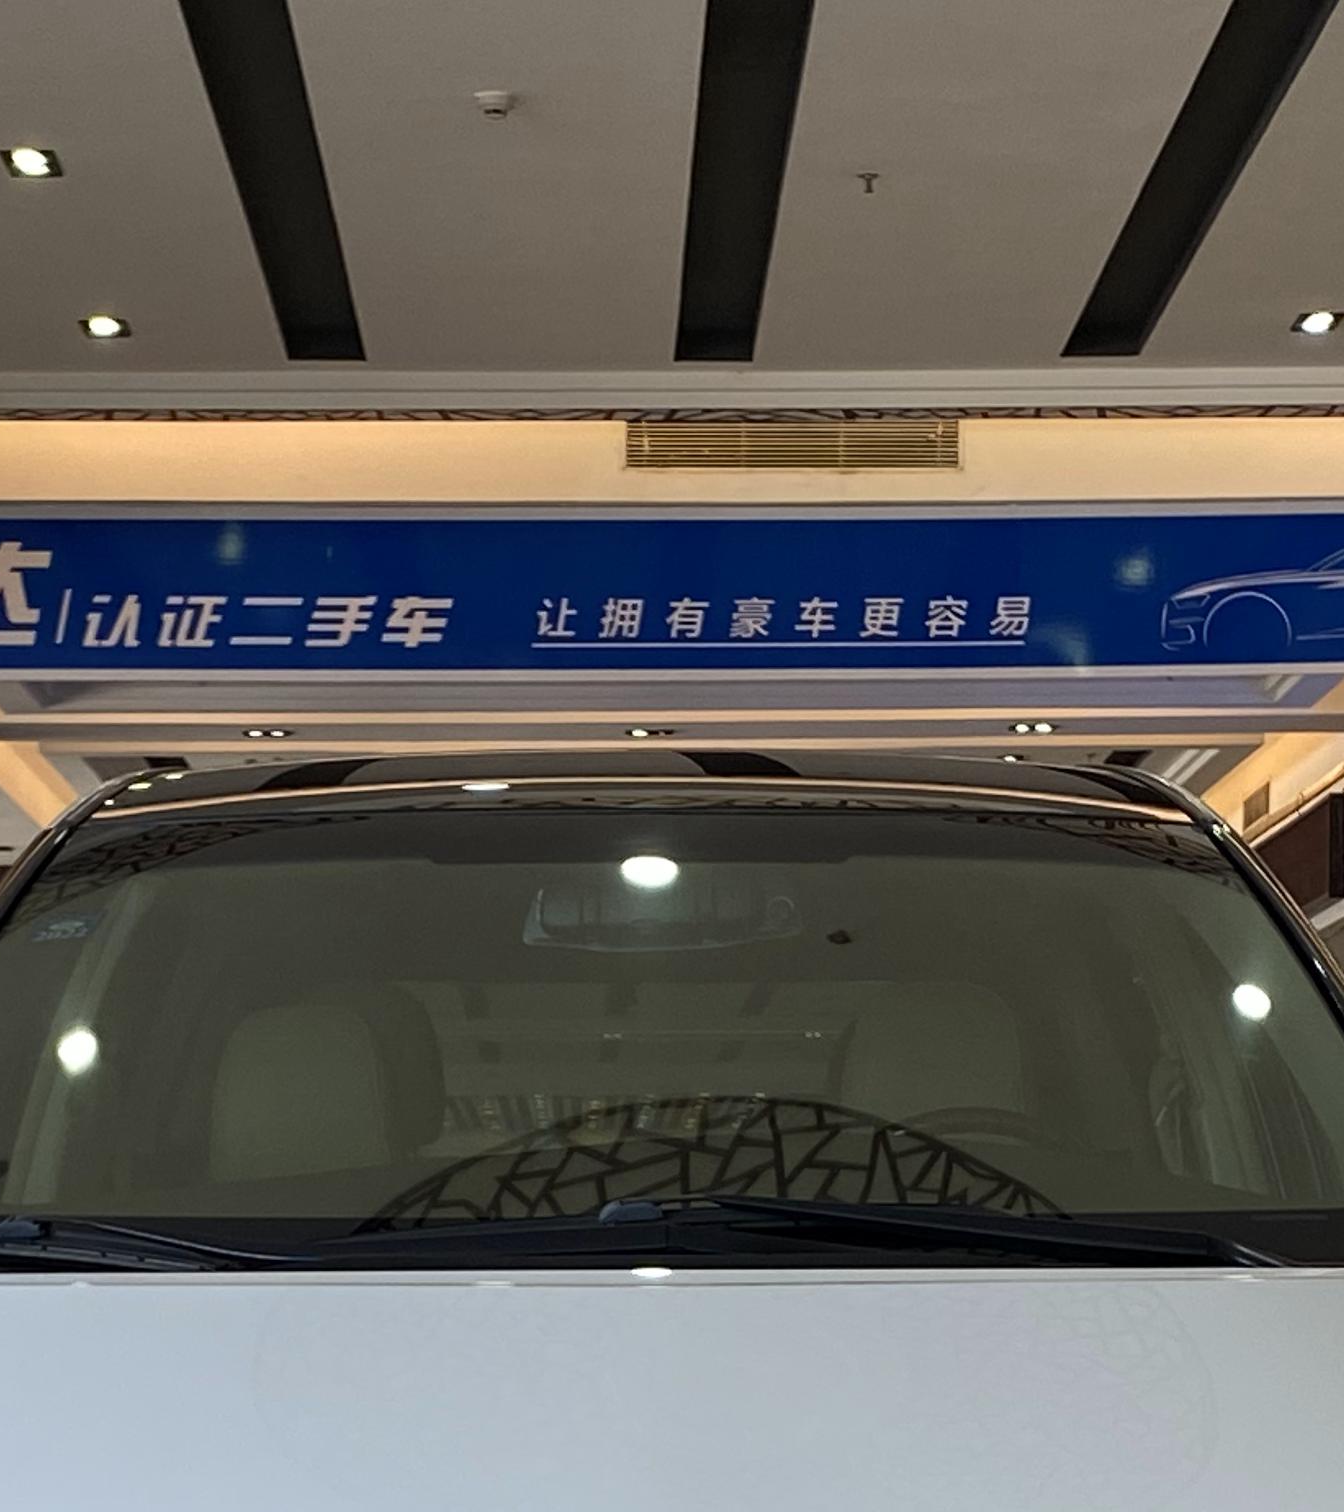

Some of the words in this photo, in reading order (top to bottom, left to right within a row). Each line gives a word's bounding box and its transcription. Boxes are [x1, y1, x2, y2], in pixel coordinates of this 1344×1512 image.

[82, 595, 454, 648] 认证二手车
[535, 596, 1032, 638] 让拥有豪车更容易
